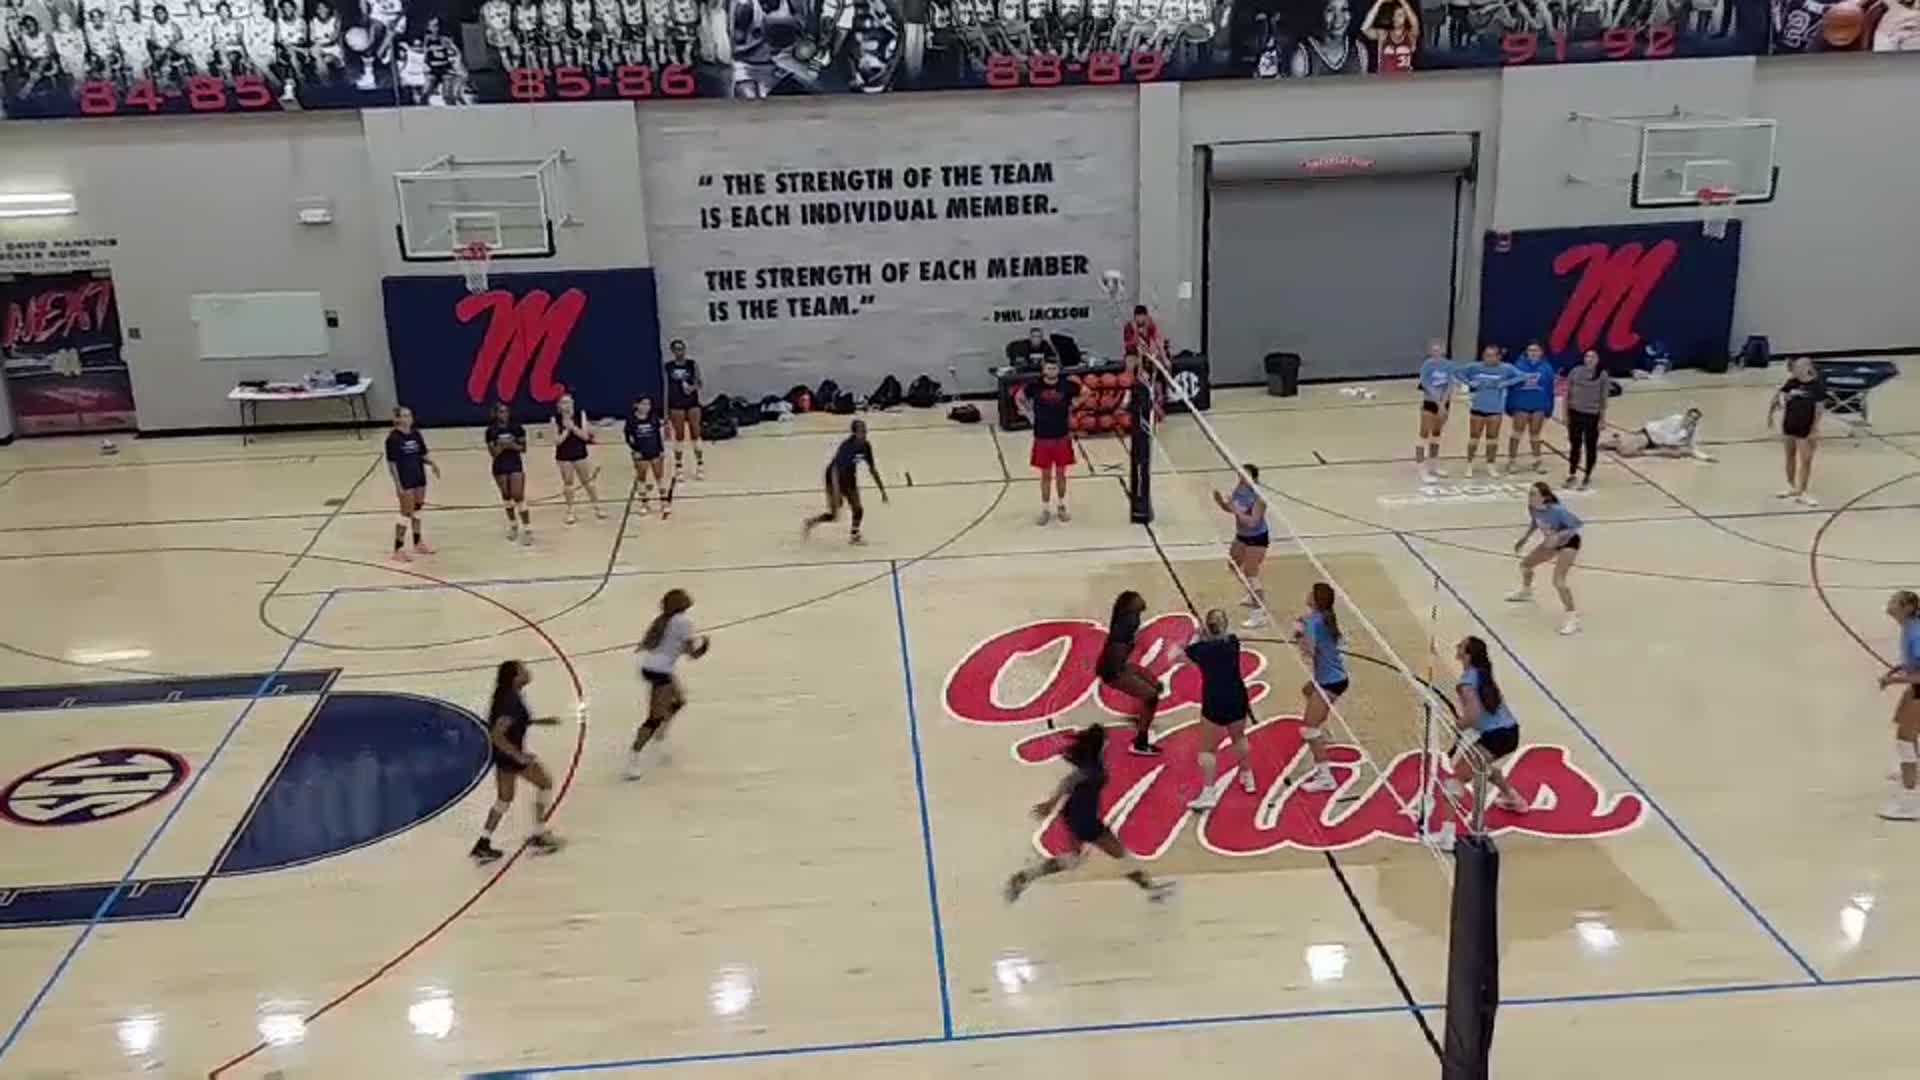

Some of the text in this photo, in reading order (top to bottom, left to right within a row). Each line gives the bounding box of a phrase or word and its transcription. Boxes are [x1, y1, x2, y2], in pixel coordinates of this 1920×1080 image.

[1502, 25, 1676, 64] 91-92
[510, 65, 696, 98] 85-86
[986, 50, 1164, 87] 88-89
[80, 75, 273, 114] 84-85
[722, 173, 767, 196] THE
[774, 168, 893, 194] STRENGTH
[902, 166, 933, 188] OF
[940, 164, 984, 187] THE
[989, 162, 1054, 185] TEAM
[700, 194, 1059, 230] IS EACH INDIVIDUAL MEMBER.
[704, 255, 1089, 292] THE STRENGTH OF EACH MEMBER
[3, 280, 113, 349] NEXT
[707, 301, 729, 322] IS
[737, 299, 779, 321] THE
[993, 309, 1025, 323] PHIL
[1028, 306, 1090, 322] JACKSON
